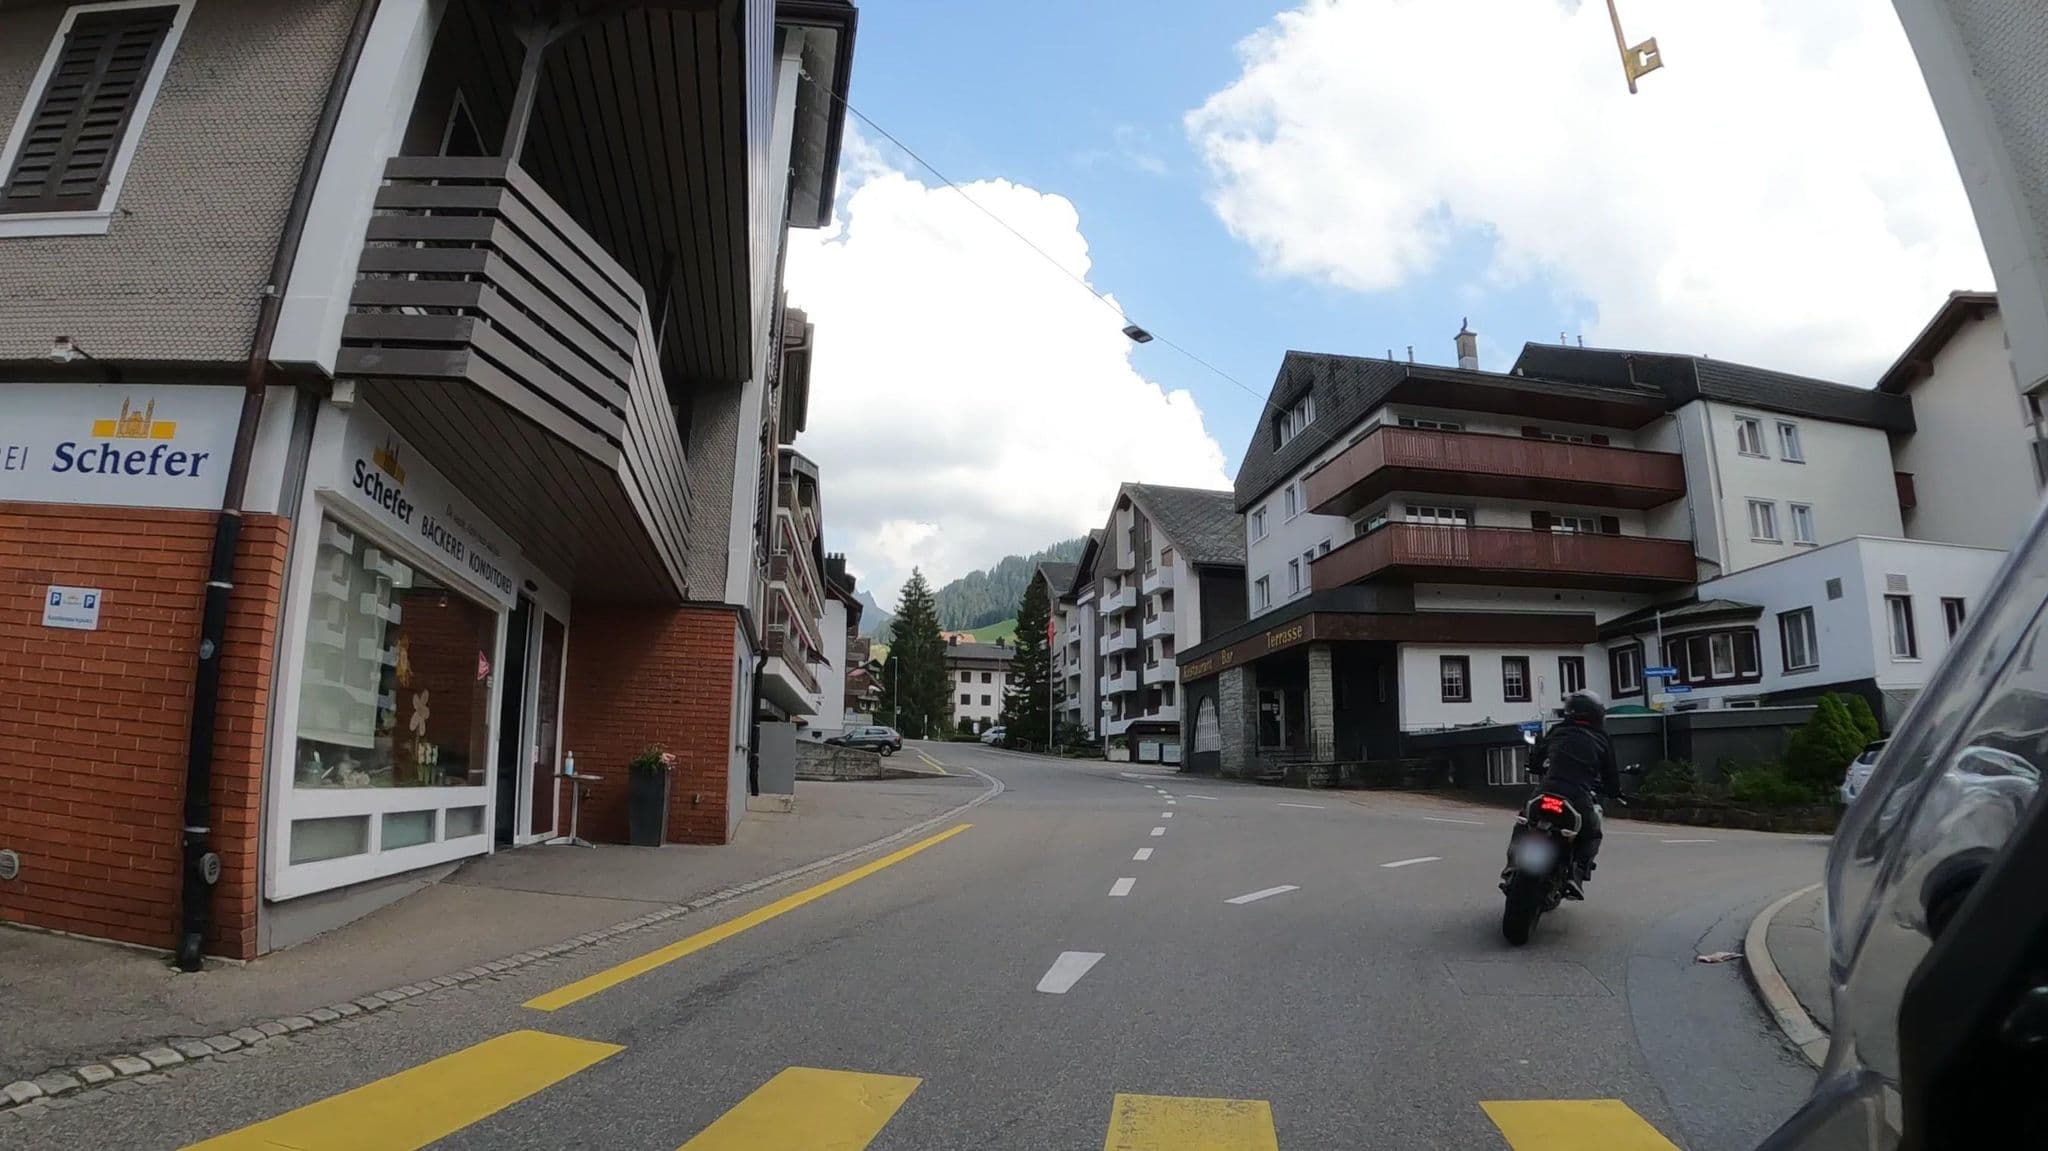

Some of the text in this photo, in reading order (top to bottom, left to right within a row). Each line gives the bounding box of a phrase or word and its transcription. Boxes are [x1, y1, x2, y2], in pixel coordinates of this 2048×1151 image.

[0, 441, 209, 477] EI Schefer
[353, 458, 414, 525] Schefer
[421, 515, 465, 562] BÄCKEREI
[468, 551, 513, 595] KONDITOREI
[1221, 649, 1234, 665] Bar
[1266, 625, 1303, 649] Terrasse
